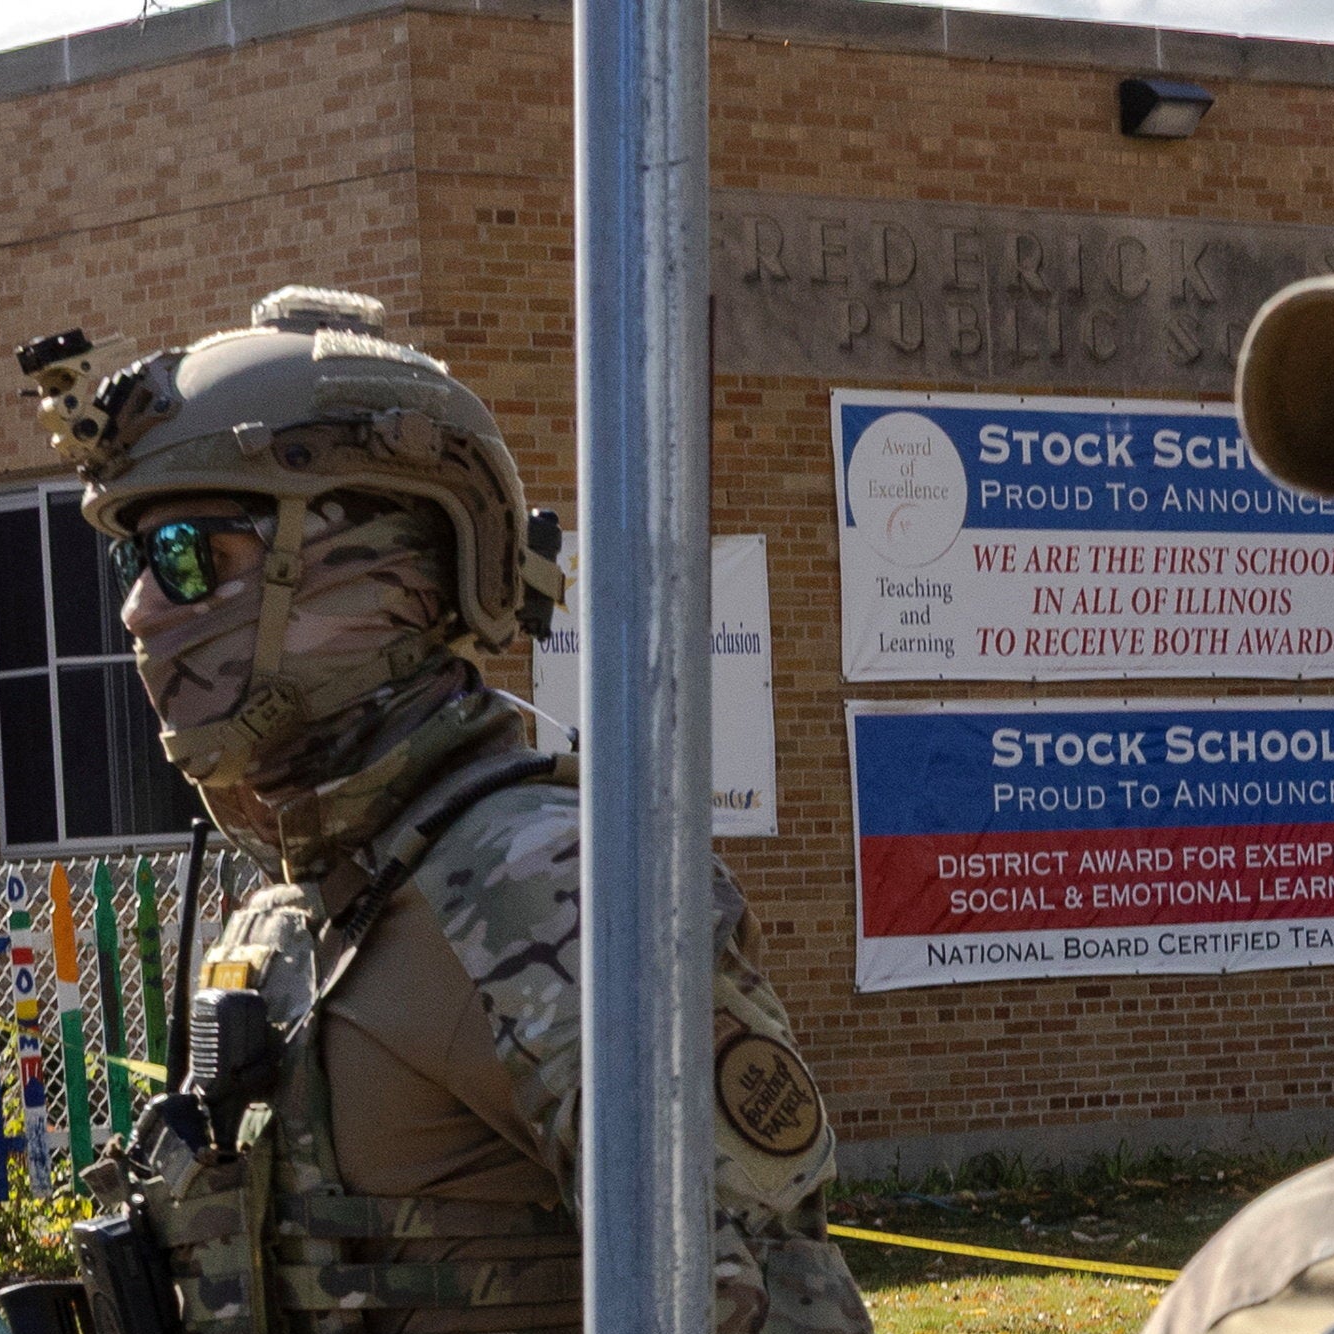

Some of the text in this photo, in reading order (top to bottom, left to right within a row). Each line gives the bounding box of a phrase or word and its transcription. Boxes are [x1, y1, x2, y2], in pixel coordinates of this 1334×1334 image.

[711, 212, 1219, 303] REDERICK
[839, 302, 1118, 363] PUBLIC
[882, 436, 932, 457] Award
[979, 424, 1245, 470] STOCK SCH
[900, 458, 916, 477] of
[868, 480, 949, 500] Excellence
[980, 480, 1093, 512] PROUD
[973, 544, 1017, 573] WE
[1024, 545, 1080, 574] ARE
[1088, 546, 1147, 575] THE
[1153, 546, 1229, 575] FIRST
[876, 576, 954, 604] Teaching
[1032, 587, 1293, 616] IN ALL OF ILLINOIS
[899, 605, 931, 626] and
[710, 621, 760, 655] clusion
[878, 632, 956, 659] Learning
[976, 627, 1016, 656] TO
[1023, 627, 1146, 656] RECEIVE
[1152, 627, 1229, 656] BOTH
[991, 728, 1147, 768] STOCK
[994, 782, 1106, 812] PROUD
[938, 851, 1069, 880] DISTRICT
[1079, 847, 1173, 874] AWARD
[1182, 845, 1235, 871] FOR
[950, 887, 1053, 914] SOCIAL
[1064, 886, 1083, 910] &
[1093, 880, 1251, 909] EMOTIONAL
[927, 936, 1054, 967] NATIONAL
[1063, 935, 1150, 960] BOARD
[1158, 929, 1280, 957] CERTIFIED
